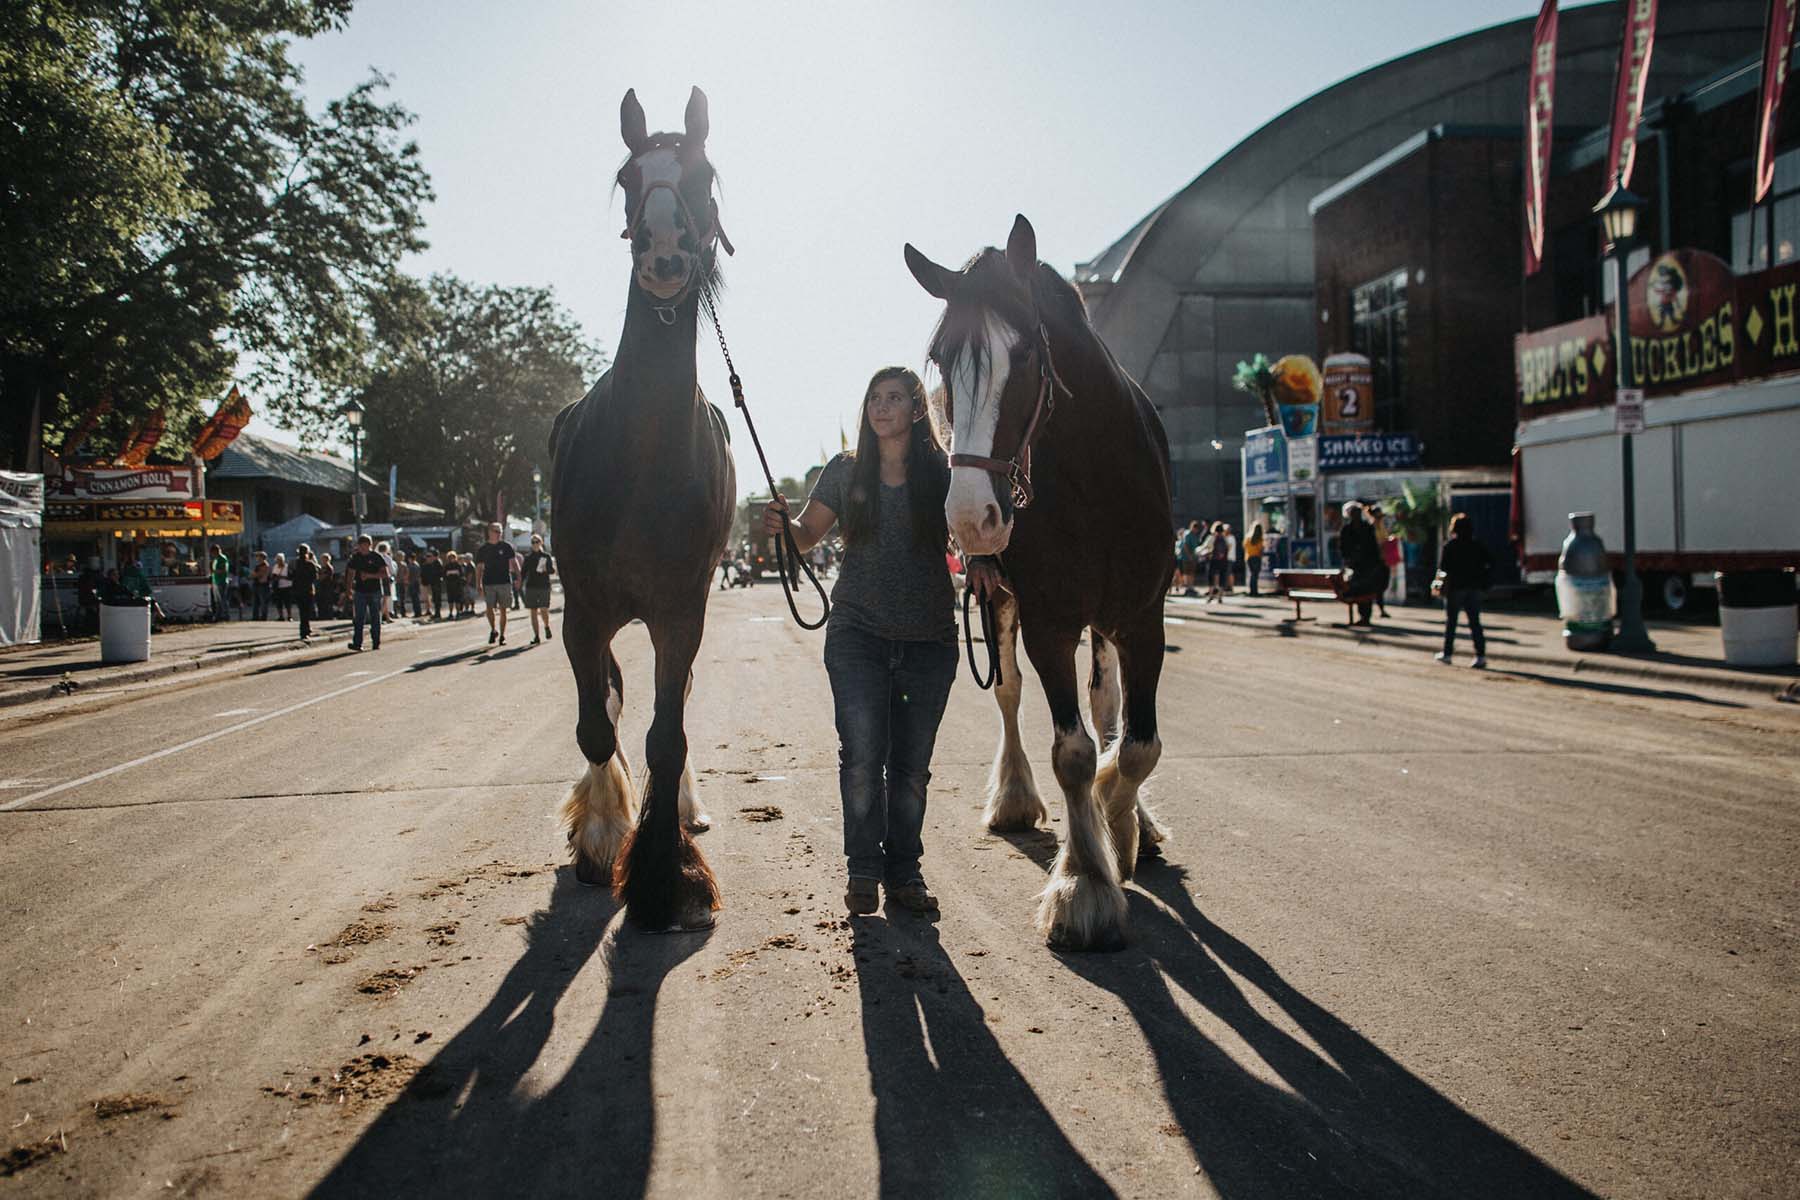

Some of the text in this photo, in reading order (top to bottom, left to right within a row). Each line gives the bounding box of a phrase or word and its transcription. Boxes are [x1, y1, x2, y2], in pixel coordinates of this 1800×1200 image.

[1521, 338, 1588, 404] BELTS
[1613, 303, 1735, 384] UCKLES
[1323, 437, 1409, 455] SHAVED ICE
[90, 473, 171, 493] CINNAMON ROLLS
[102, 507, 202, 520] ROLLS
